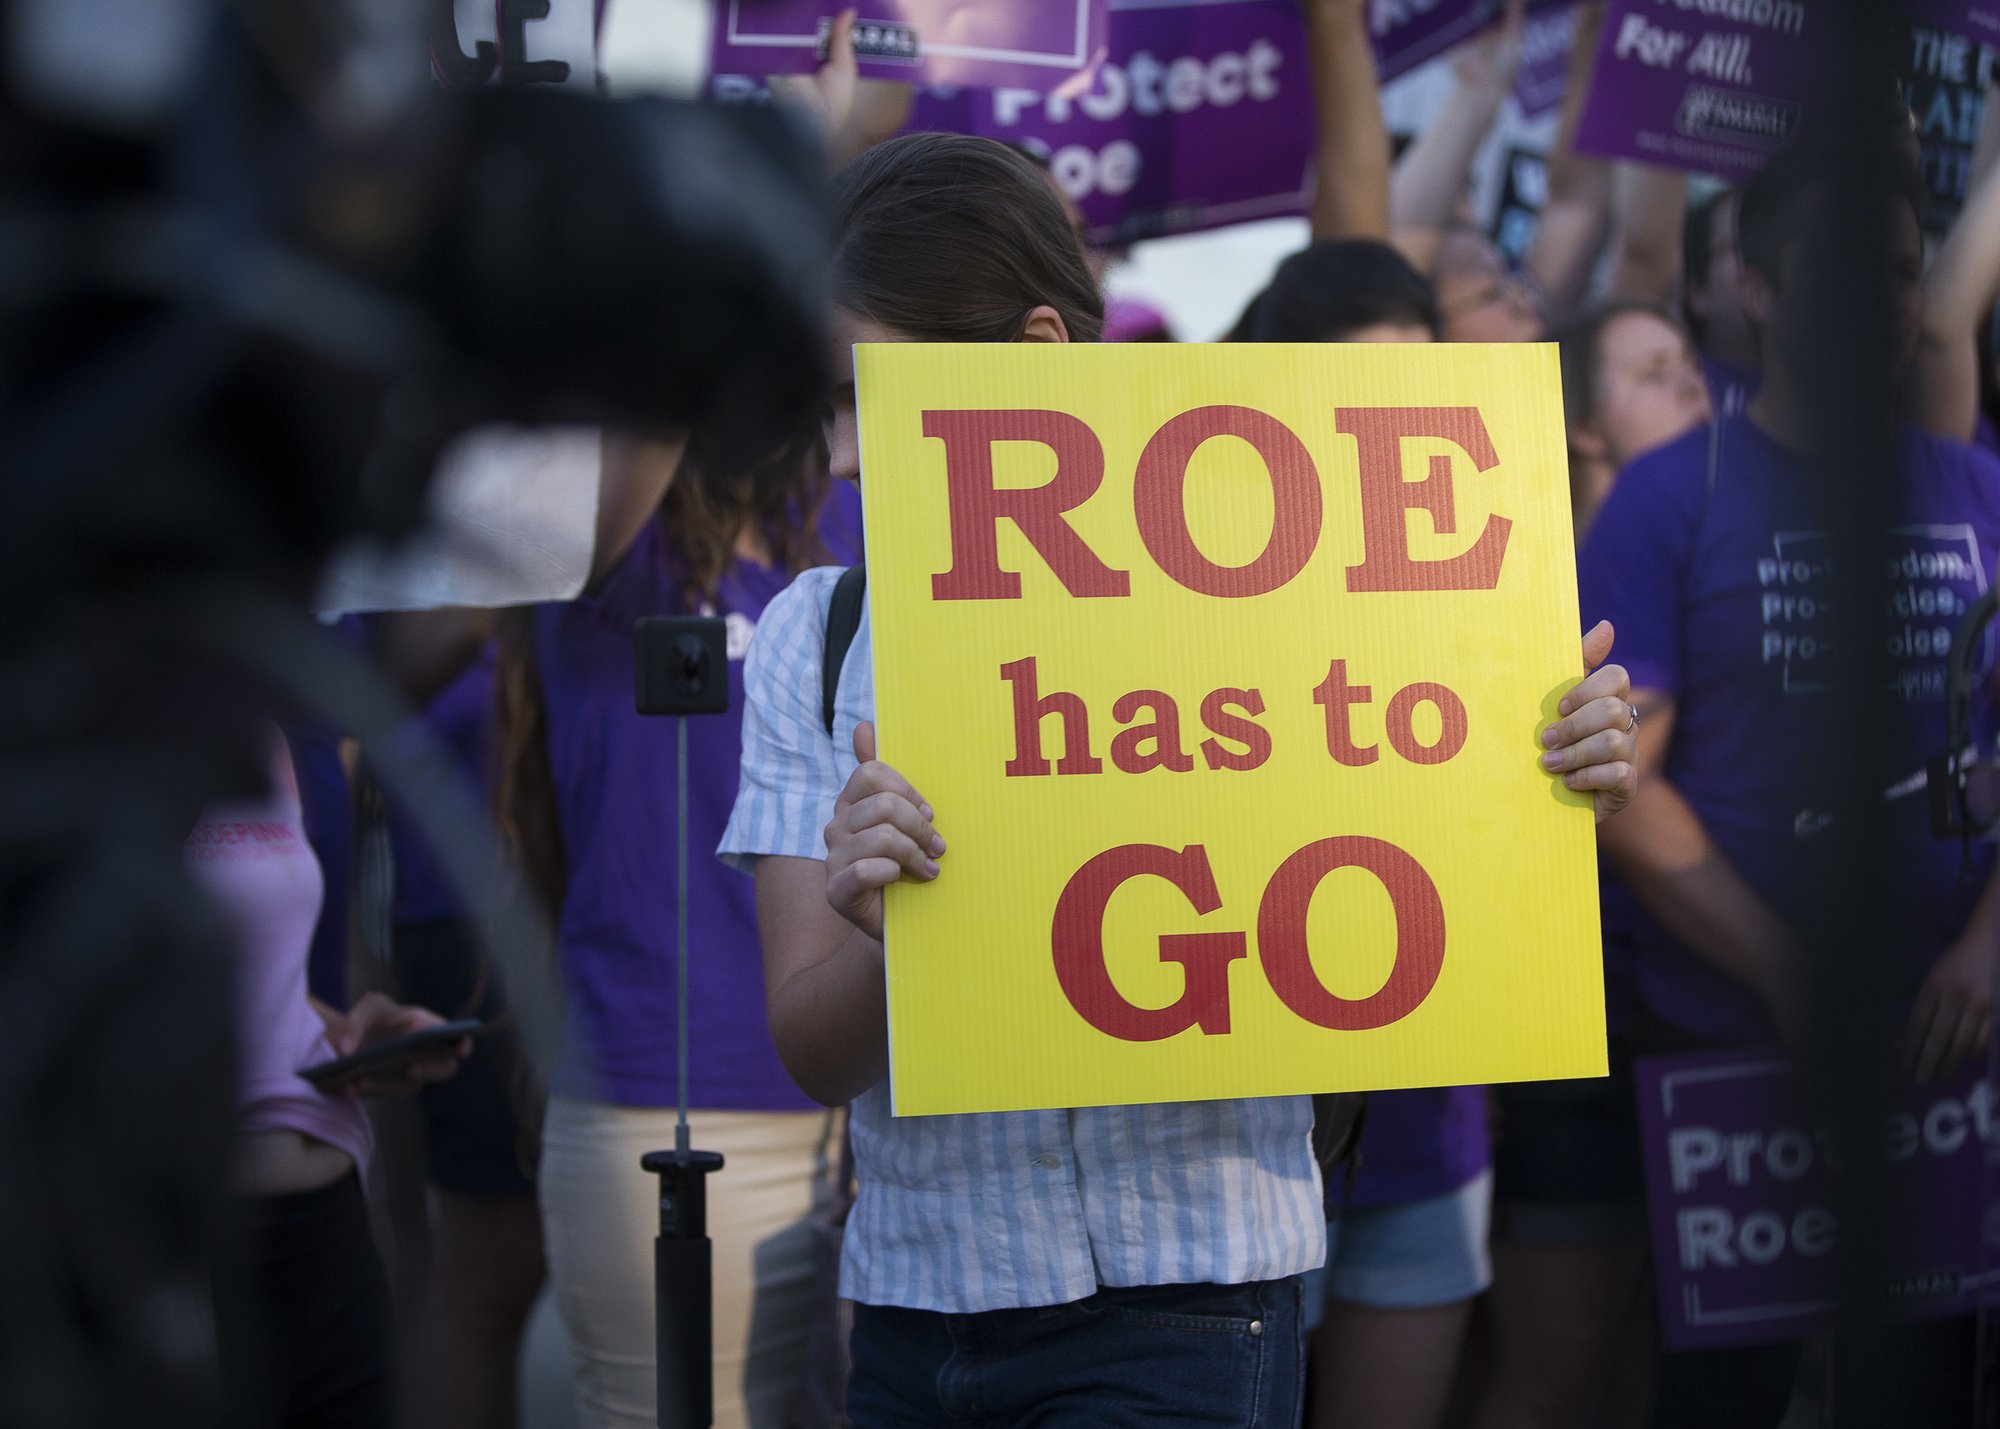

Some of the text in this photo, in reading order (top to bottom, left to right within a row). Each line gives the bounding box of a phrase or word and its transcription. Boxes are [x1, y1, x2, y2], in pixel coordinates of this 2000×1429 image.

[1613, 12, 1686, 69] For
[1686, 31, 1753, 85] All.
[921, 405, 1513, 601] ROE
[1001, 657, 1468, 777] has to
[1051, 835, 1446, 1042] GO
[1668, 1078, 1992, 1194] Proect
[1676, 1205, 1838, 1270] Roe
